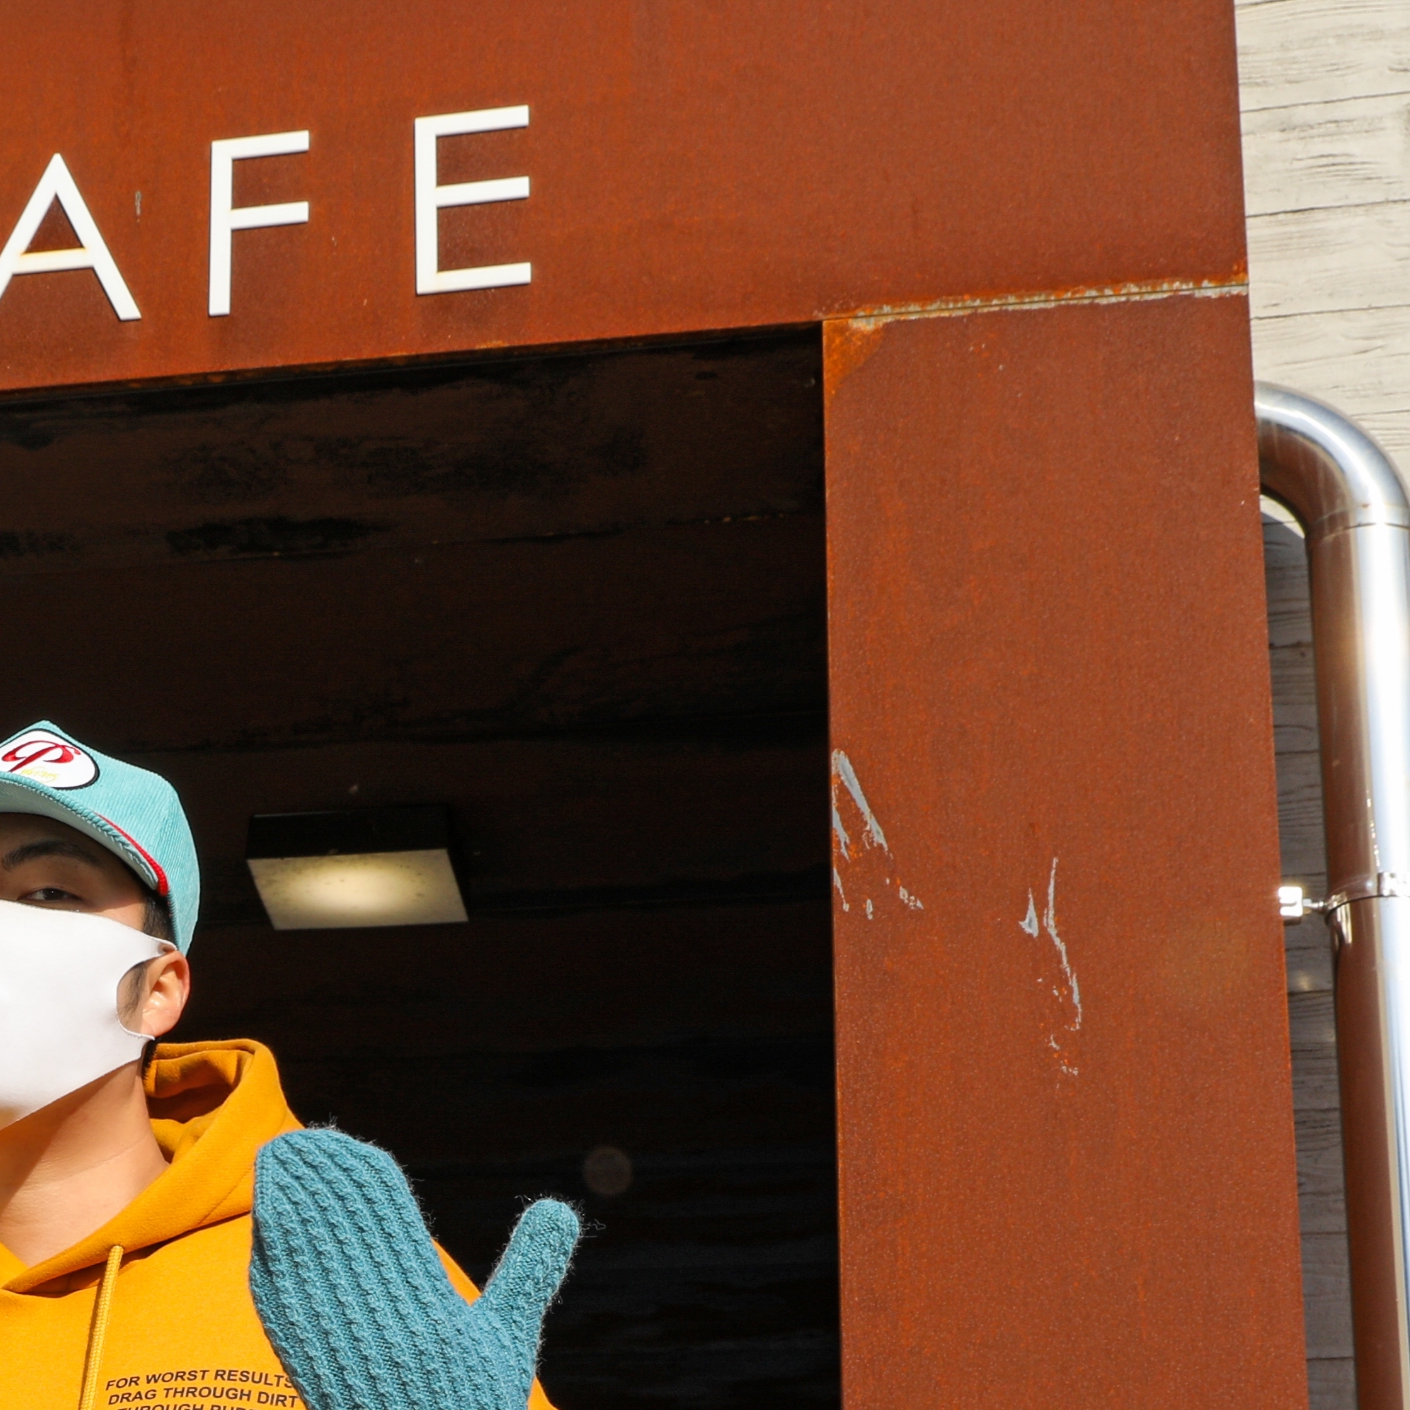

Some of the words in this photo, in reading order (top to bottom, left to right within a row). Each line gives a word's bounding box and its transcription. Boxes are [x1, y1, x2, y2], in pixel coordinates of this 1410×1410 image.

[105, 1376, 141, 1391] FOR
[145, 1369, 210, 1385] WORST
[213, 1369, 294, 1389] RESULTS
[108, 1389, 158, 1406] DRAG
[163, 1386, 252, 1402] THROUGH
[256, 1391, 299, 1408] DIRT
